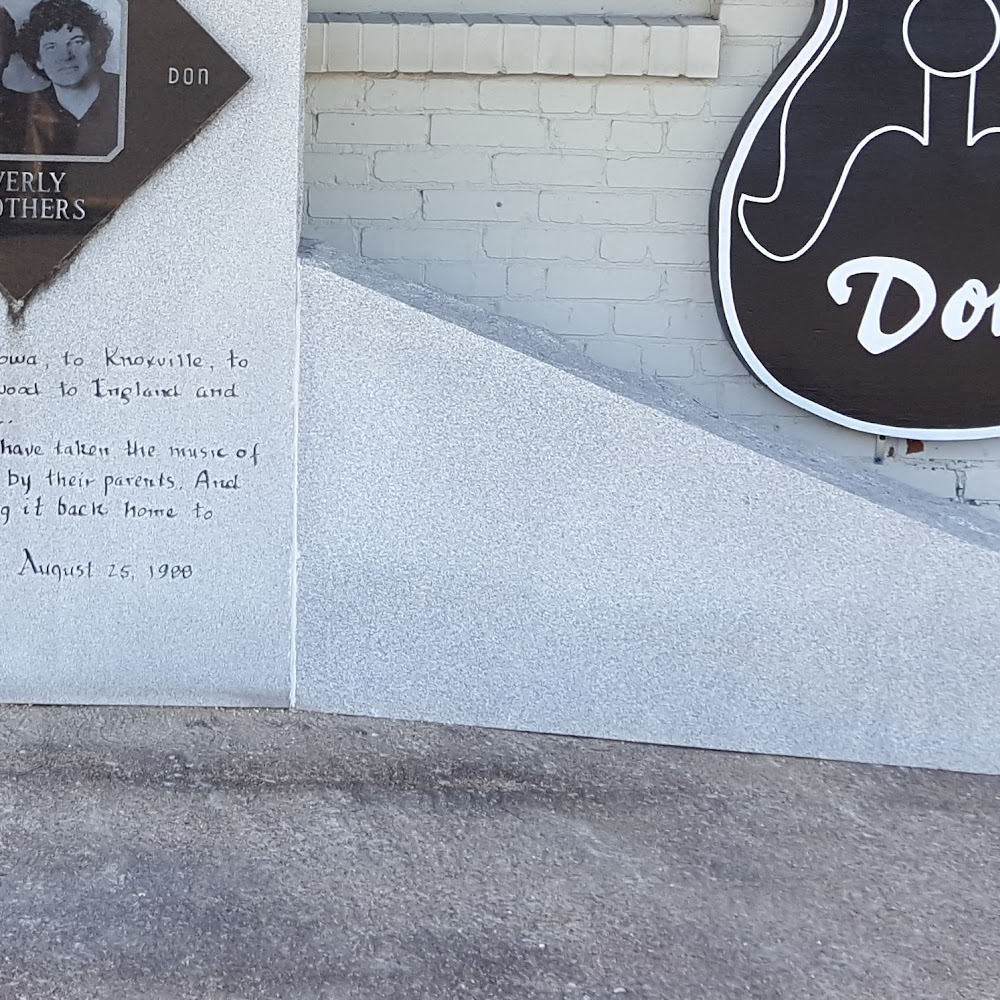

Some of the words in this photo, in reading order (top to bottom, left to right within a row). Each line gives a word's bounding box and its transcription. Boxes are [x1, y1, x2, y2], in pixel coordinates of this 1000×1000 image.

[167, 67, 209, 86] DON
[827, 256, 1000, 355] Do
[63, 350, 84, 366] to
[104, 346, 214, 371] Knoxville,
[227, 349, 249, 368] to
[59, 381, 78, 398] to
[91, 377, 181, 405] England
[196, 383, 239, 398] and
[0, 439, 44, 456] have
[53, 440, 110, 456] taken
[124, 440, 160, 457] the
[170, 444, 229, 459] music
[236, 443, 260, 466] of
[7, 469, 32, 494] by
[45, 468, 95, 488] their
[194, 469, 241, 490] And
[22, 496, 44, 516] it
[57, 496, 108, 517] back
[124, 501, 178, 518] home
[193, 502, 213, 520] to
[18, 548, 93, 582] August
[108, 564, 135, 582] 25,
[149, 563, 193, 579] 1988
